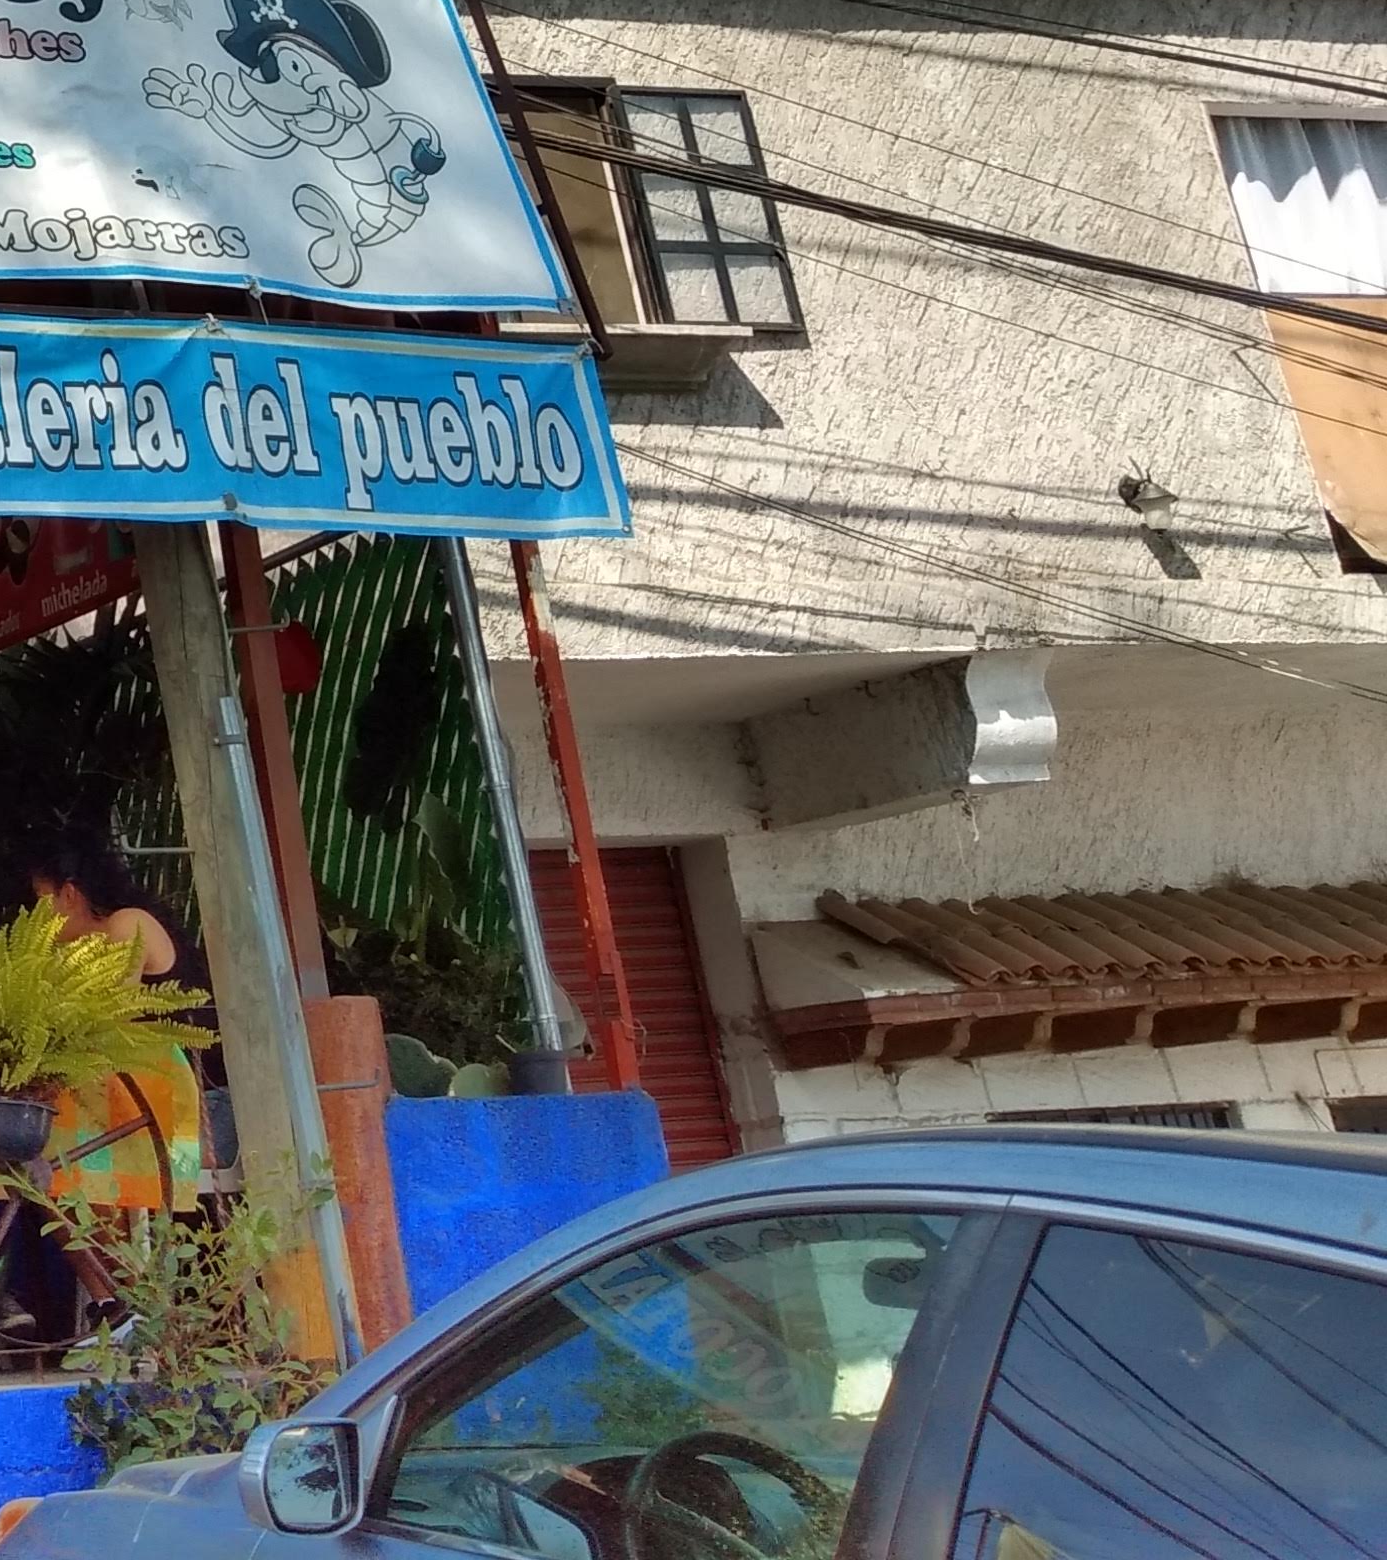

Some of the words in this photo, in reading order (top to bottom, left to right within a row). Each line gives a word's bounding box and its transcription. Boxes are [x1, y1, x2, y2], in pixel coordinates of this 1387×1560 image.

[202, 352, 324, 478] del
[330, 371, 585, 513] pueblo
[40, 568, 108, 618] michelada
